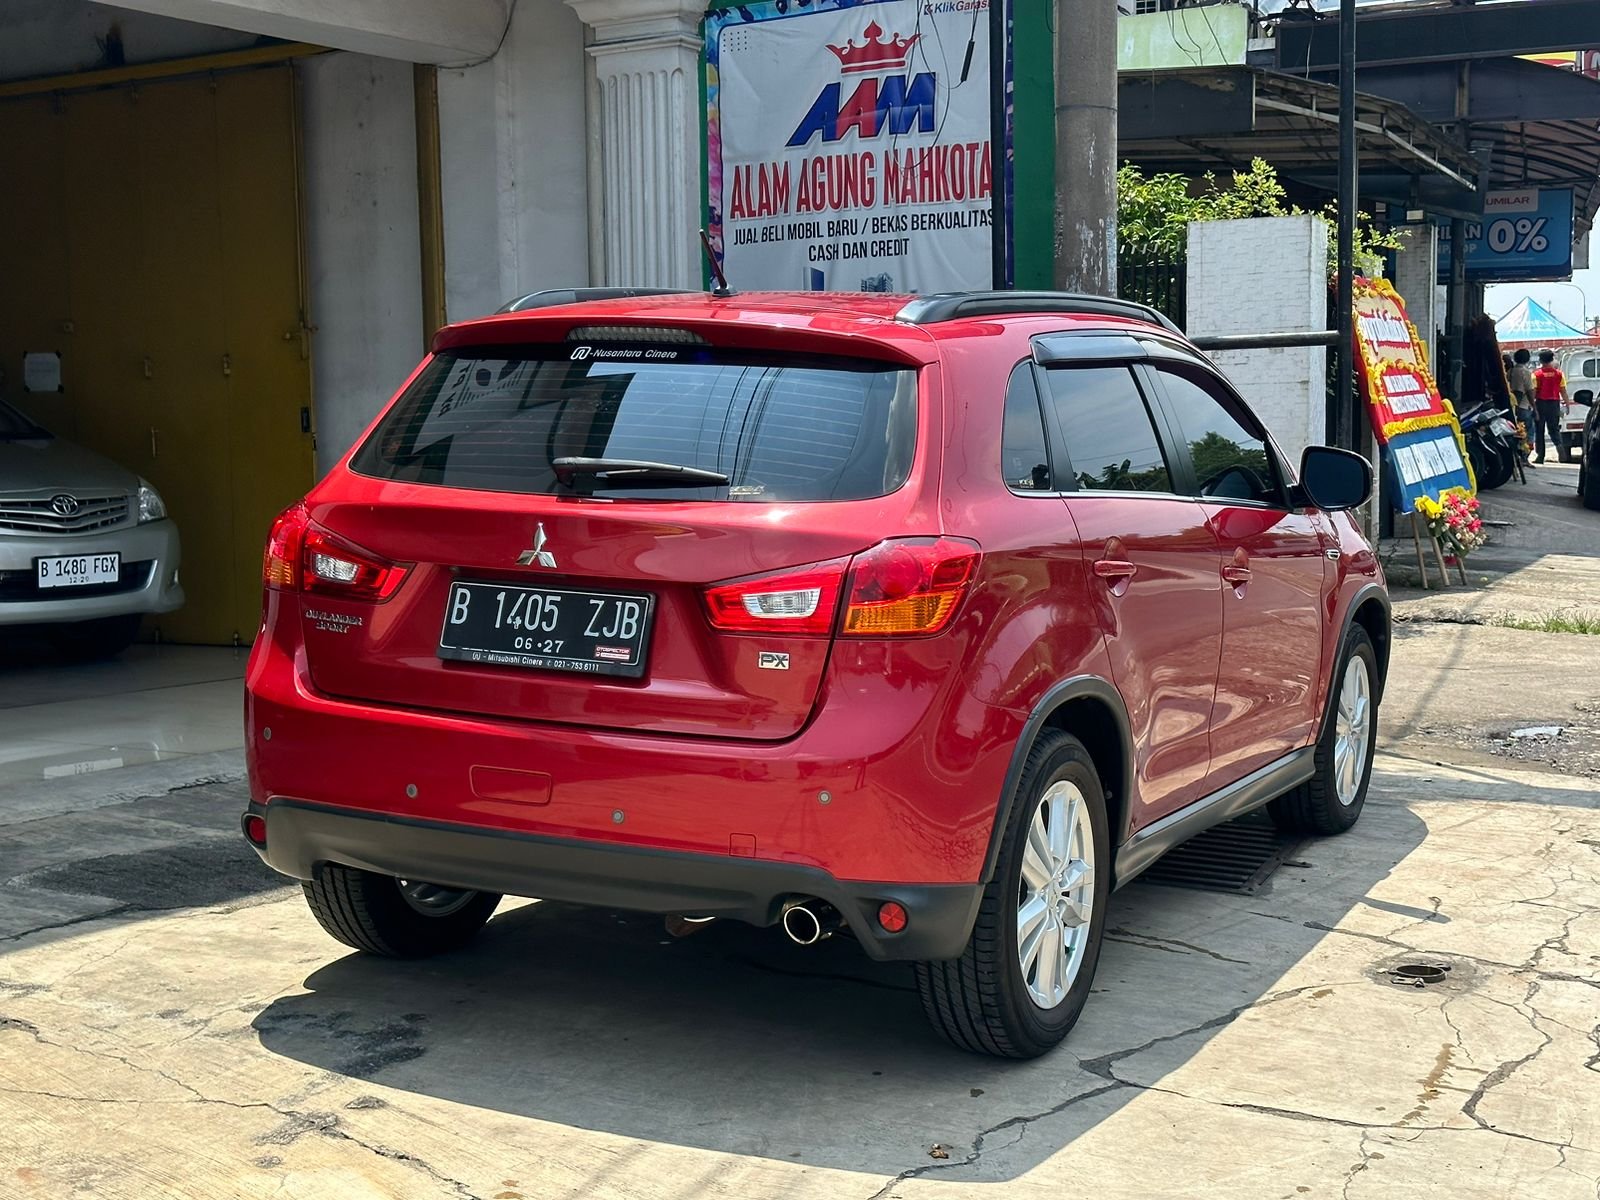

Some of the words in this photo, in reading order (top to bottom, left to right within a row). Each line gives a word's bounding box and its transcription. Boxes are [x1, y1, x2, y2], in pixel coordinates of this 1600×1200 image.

[934, 0, 991, 13] KlikGaras
[785, 71, 936, 147] AAM
[730, 161, 790, 219] ALAM
[796, 151, 875, 213] AGUNG
[883, 141, 992, 206] MAHKOTA
[1486, 196, 1530, 206] UMILAR
[733, 227, 758, 246] JUAL
[761, 224, 784, 243] BELI
[787, 221, 824, 241] MOBIL
[827, 218, 858, 238] BARU
[872, 214, 908, 234] BEKAS
[911, 208, 993, 231] BERKUALITAS
[808, 242, 839, 262] CASH
[842, 241, 868, 259] DAN
[870, 238, 910, 258] CREDIT
[592, 349, 643, 358] Nusantara
[645, 349, 678, 359] Cinere
[41, 561, 49, 577] B
[55, 558, 87, 576] 1480
[94, 556, 116, 573] FGX
[305, 609, 363, 625] OUTLANDER
[450, 587, 471, 625] B
[495, 591, 561, 632] 1405
[583, 599, 640, 640] ZJB
[315, 621, 350, 633] SPORT
[487, 652, 520, 664] Mitsubishi
[521, 656, 543, 666] Cinere
